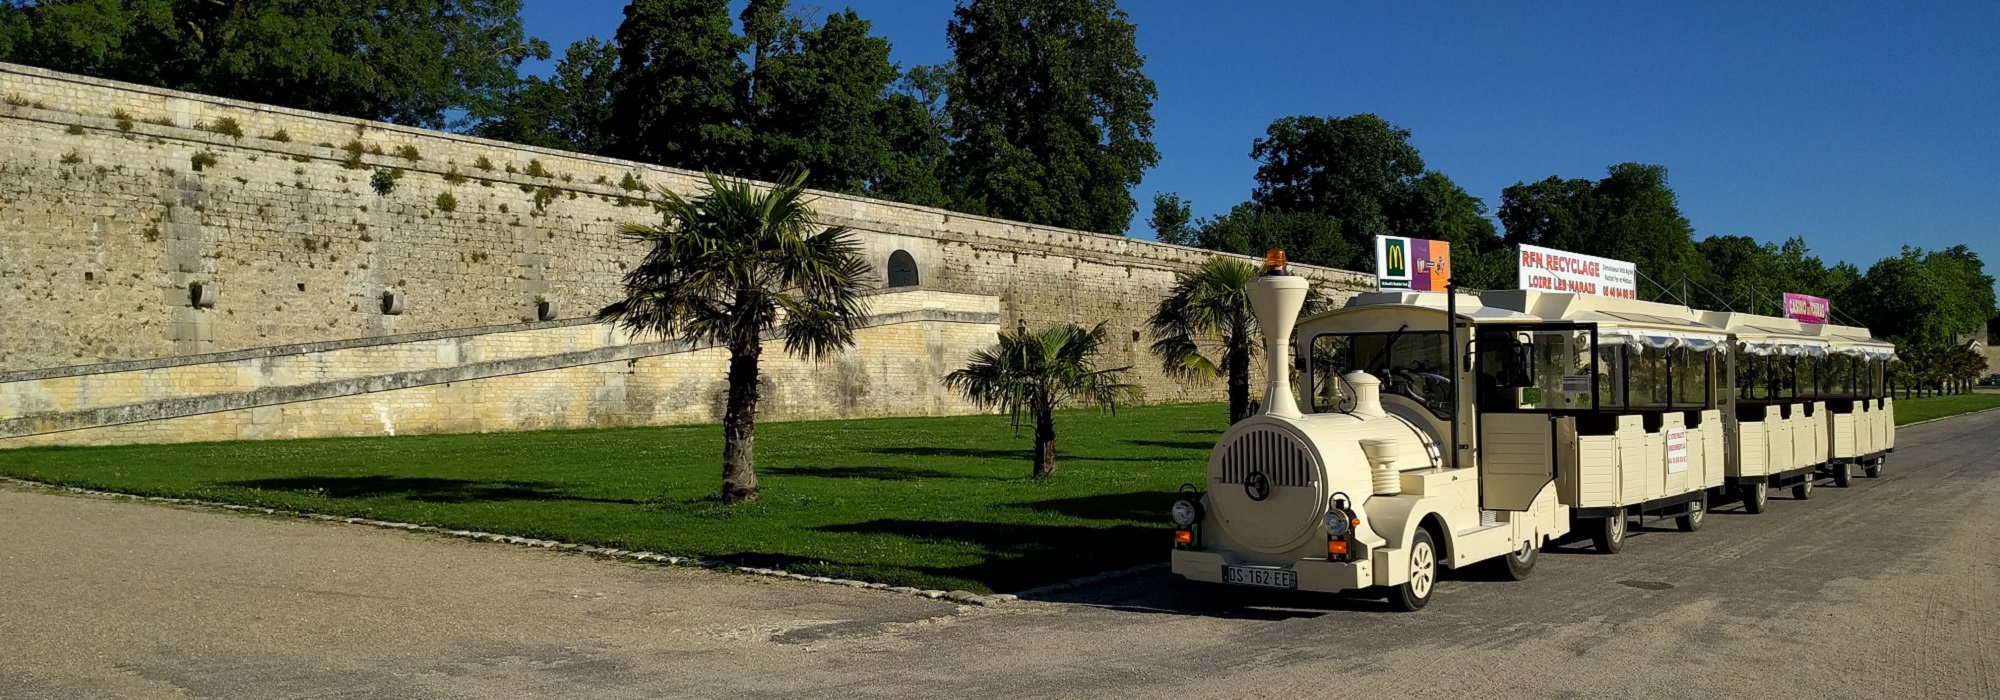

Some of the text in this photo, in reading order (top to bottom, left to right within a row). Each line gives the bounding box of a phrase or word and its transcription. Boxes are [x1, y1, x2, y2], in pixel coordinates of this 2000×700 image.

[1522, 250, 1600, 277] RFN RECYCLAGE
[1528, 274, 1596, 294] LOIRE LES MARAIS
[1790, 298, 1806, 315] CASINO
